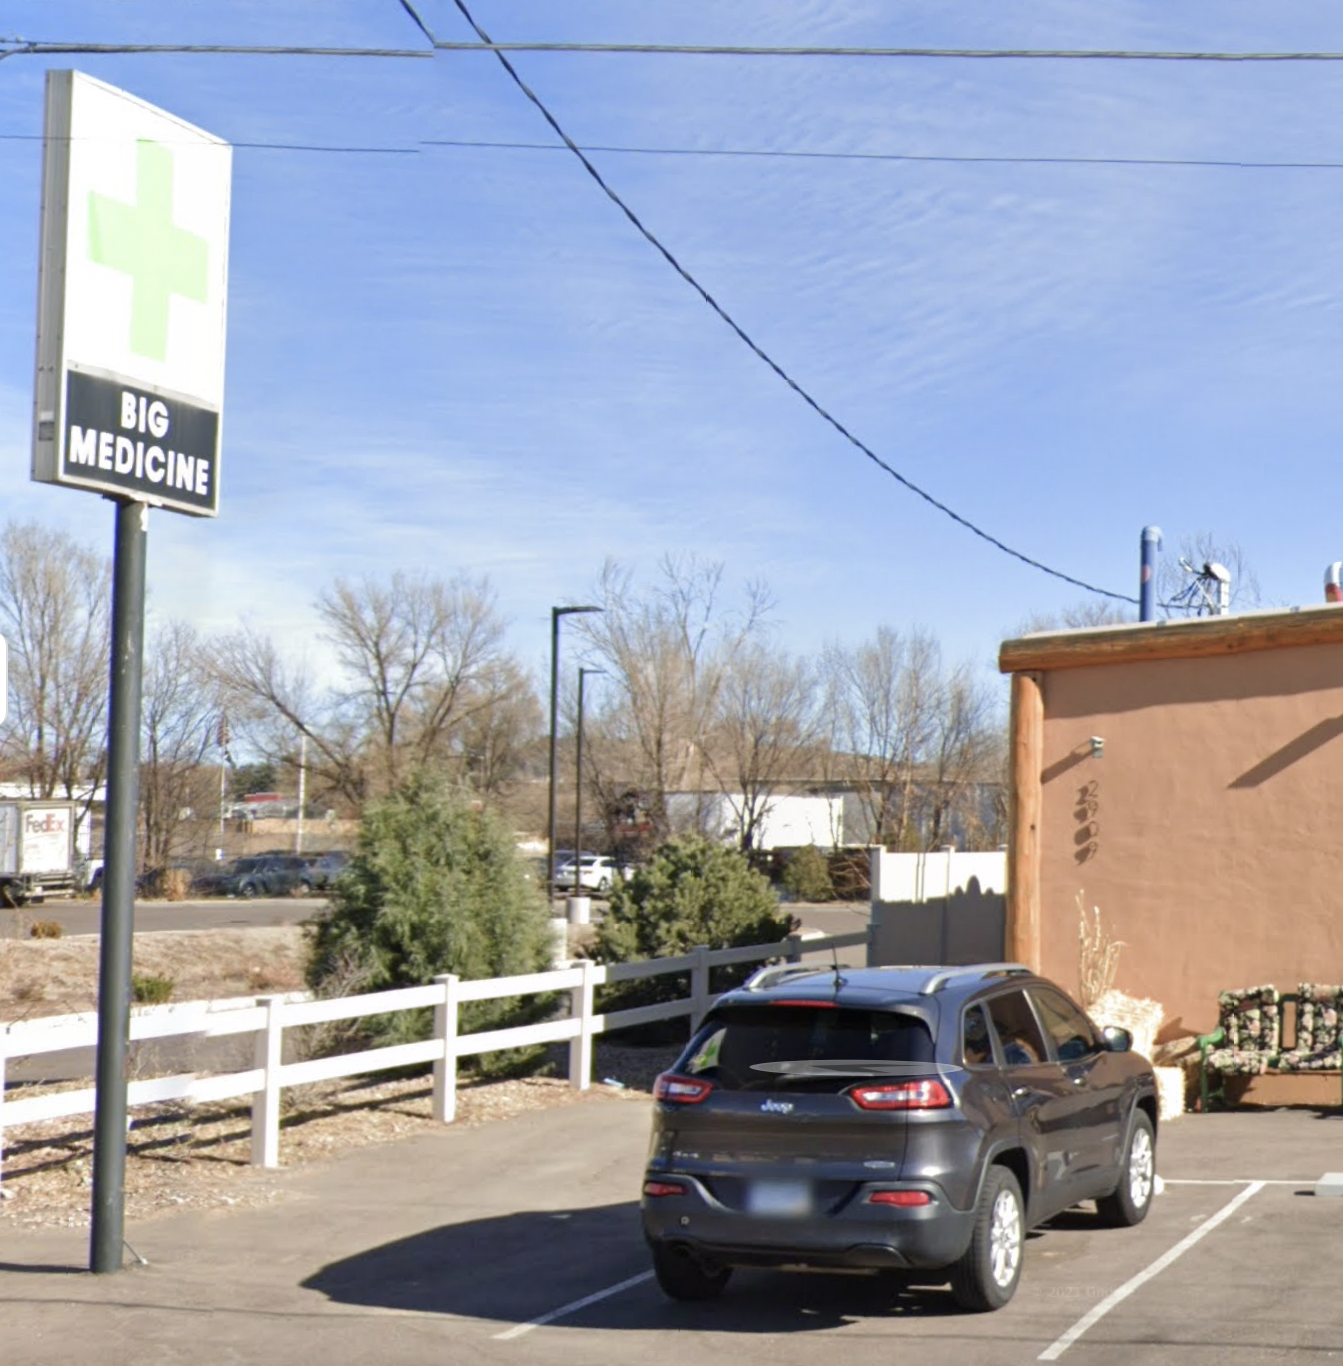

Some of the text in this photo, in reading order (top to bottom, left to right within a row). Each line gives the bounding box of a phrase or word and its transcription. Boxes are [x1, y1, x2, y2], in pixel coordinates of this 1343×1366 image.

[121, 391, 169, 438] BIG
[69, 426, 209, 495] MEDICINE
[26, 813, 65, 832] FedEx
